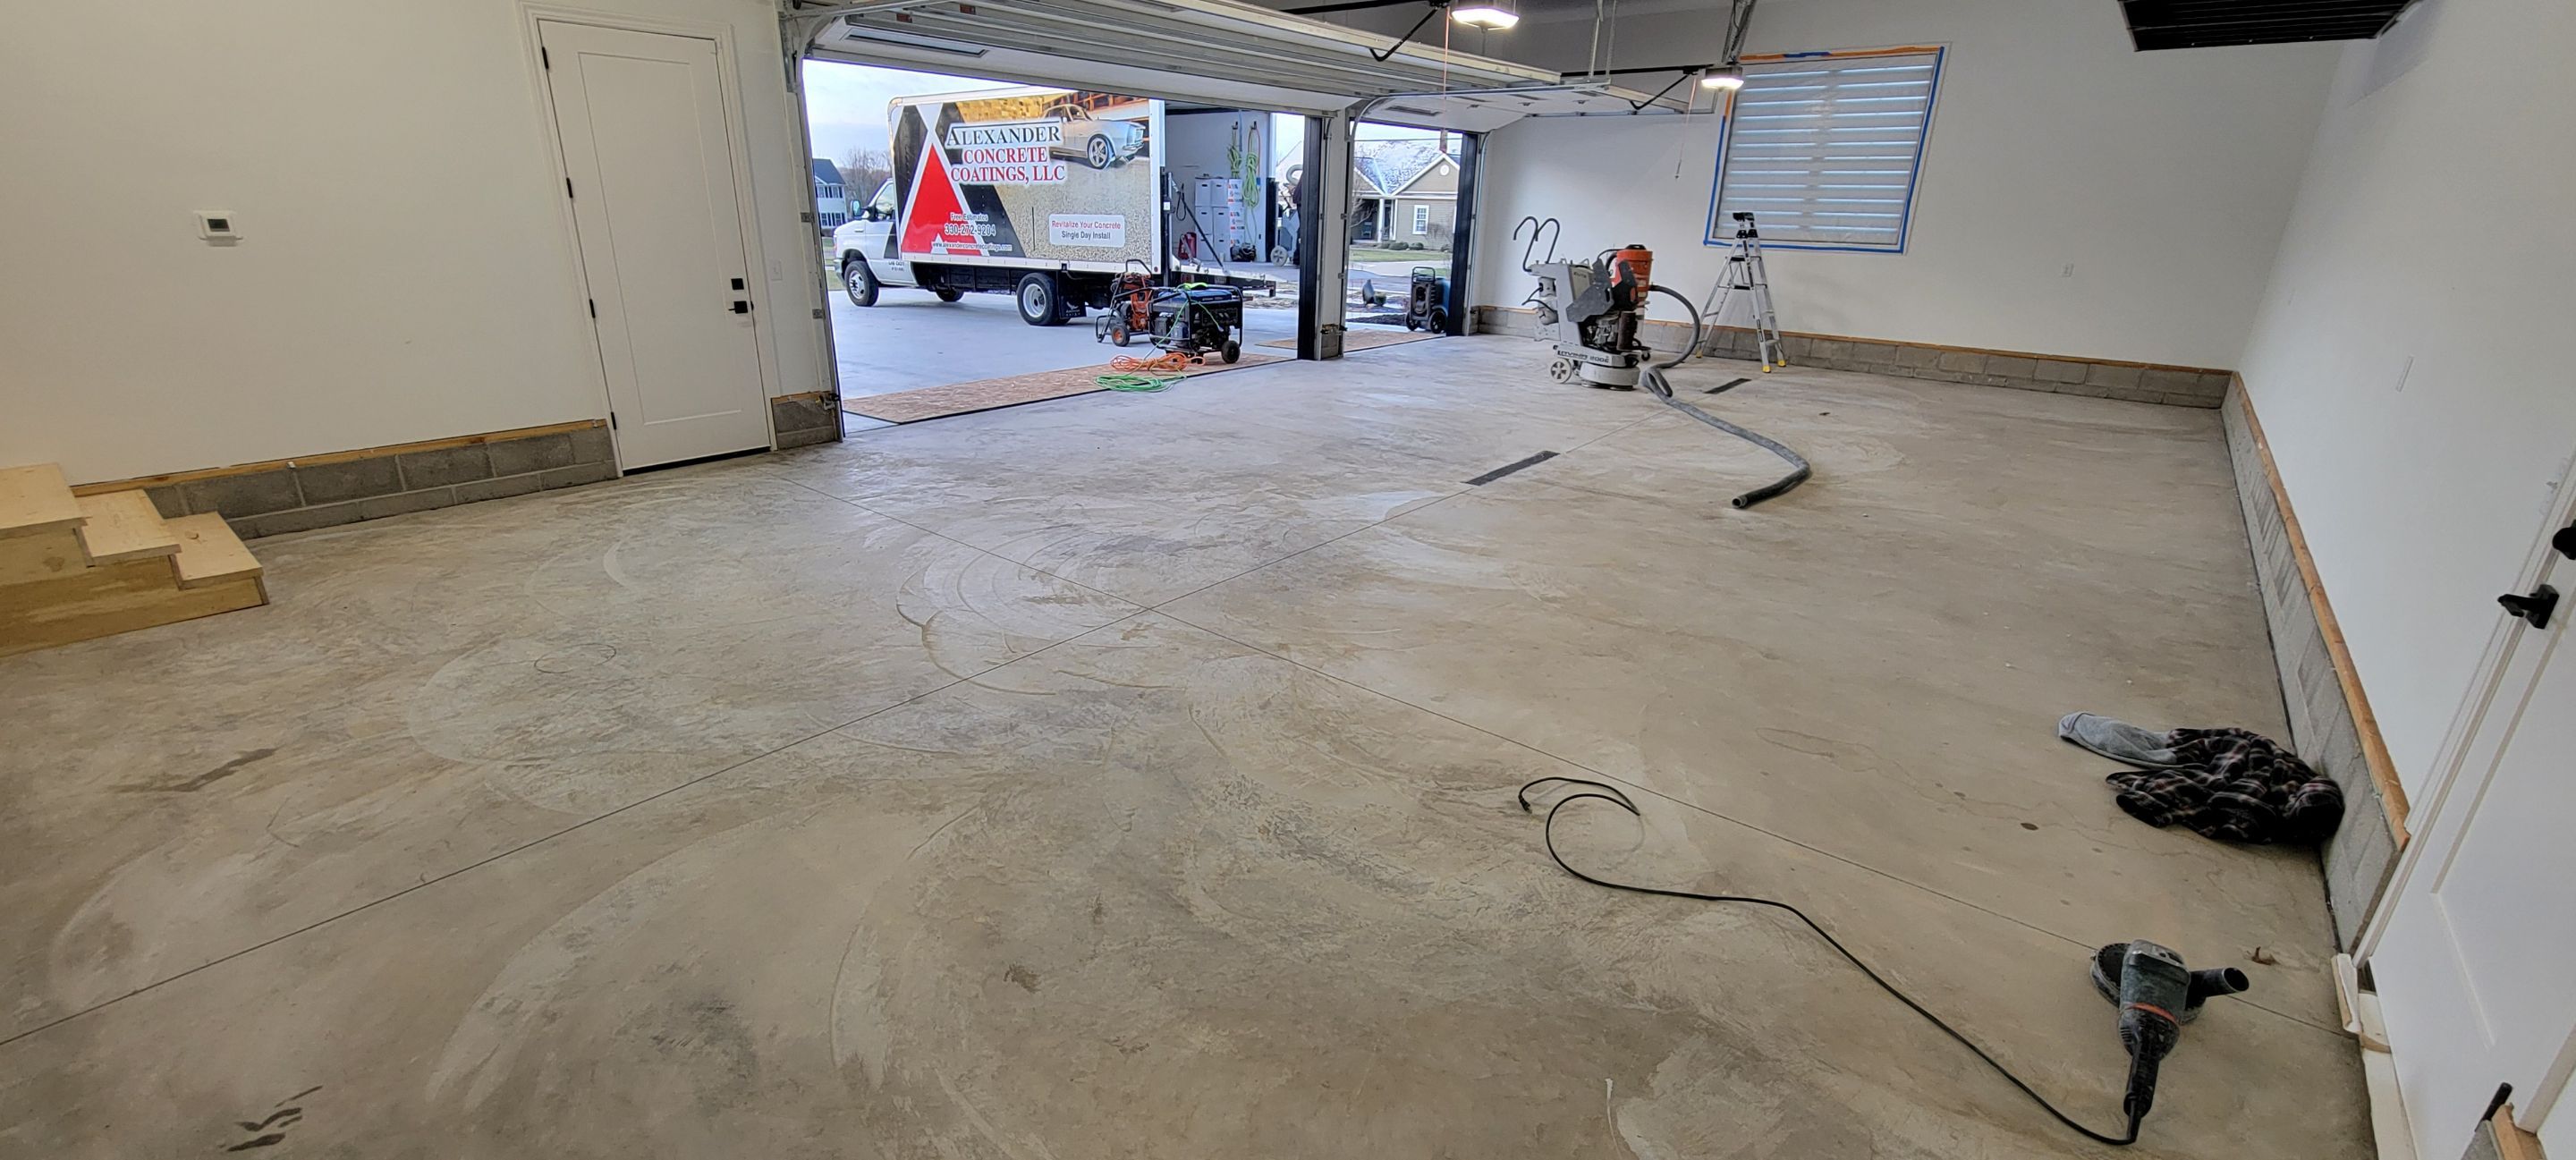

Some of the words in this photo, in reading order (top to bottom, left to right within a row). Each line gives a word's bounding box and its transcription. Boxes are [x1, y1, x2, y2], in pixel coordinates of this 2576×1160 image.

[947, 125, 1061, 145] ALEXANDER
[963, 147, 1047, 163] CONCRETE
[950, 166, 1030, 184] COATINGS,
[1032, 165, 1066, 182] LLC
[951, 212, 962, 222] Free
[964, 213, 988, 222] Estimates
[945, 224, 996, 236] 330-272-9204
[1051, 220, 1079, 229] Revitalize
[1080, 221, 1093, 229] Your
[1094, 221, 1122, 230] Concrete
[1061, 230, 1080, 241] Single
[1080, 231, 1092, 241] Day
[1092, 231, 1111, 240] Install
